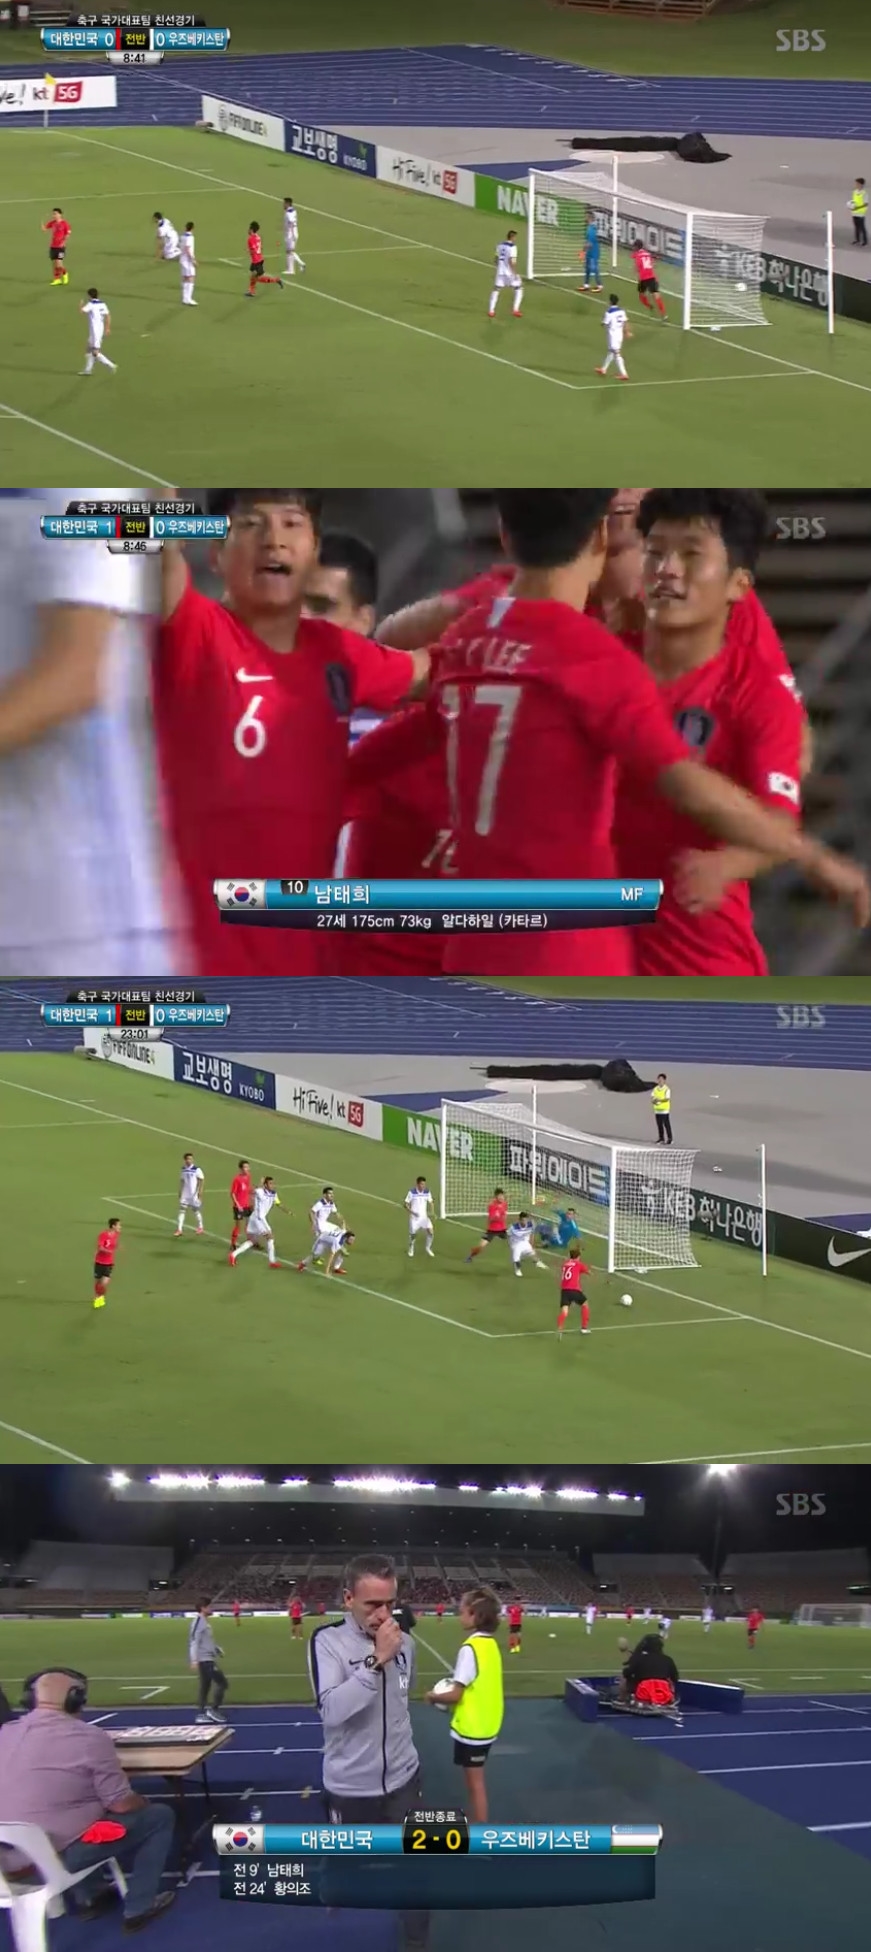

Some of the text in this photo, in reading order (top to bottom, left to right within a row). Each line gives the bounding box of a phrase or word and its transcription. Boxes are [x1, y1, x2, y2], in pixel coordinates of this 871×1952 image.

[33, 87, 49, 100] kt
[291, 125, 338, 164] 교보생명
[497, 185, 560, 227] NAVER
[234, 695, 266, 758] 6
[442, 684, 523, 837] 17
[182, 1052, 232, 1094] 교보생명
[239, 1082, 265, 1102] KYOBO
[336, 1102, 346, 1119] kt
[407, 1116, 474, 1161] NAVER
[562, 1266, 573, 1280] 16
